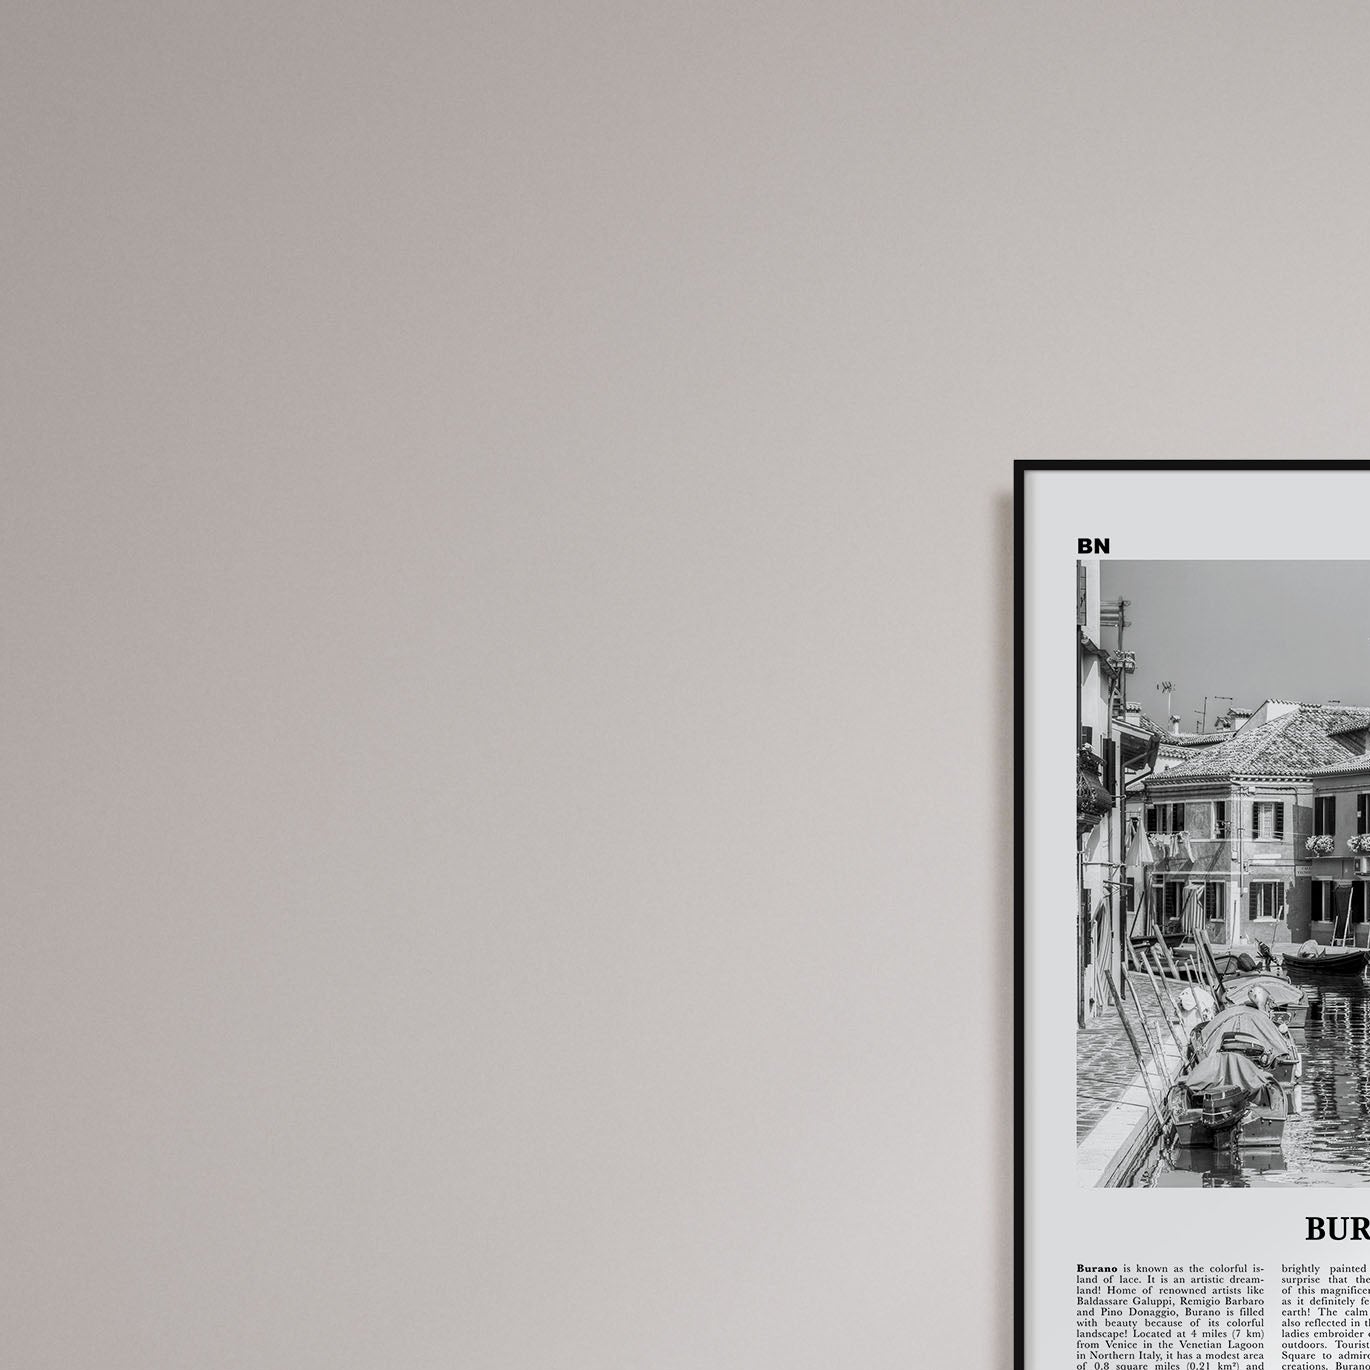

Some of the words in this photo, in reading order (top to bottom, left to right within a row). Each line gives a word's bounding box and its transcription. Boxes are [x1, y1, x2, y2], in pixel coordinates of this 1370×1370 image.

[1077, 538, 1110, 554] BN
[1077, 1264, 1117, 1272] Burano
[1124, 1264, 1130, 1272] is
[1137, 1264, 1168, 1272] known
[1189, 1264, 1204, 1272] the
[1210, 1264, 1247, 1272] colorful
[1253, 1264, 1264, 1272] is-
[1282, 1264, 1320, 1275] brightly
[1330, 1264, 1366, 1275] painted
[1282, 1275, 1320, 1286] surprise
[1329, 1275, 1347, 1283] that
[1356, 1275, 1370, 1283] the
[1077, 1285, 1100, 1294] land!
[1107, 1285, 1136, 1294] Home
[1142, 1285, 1153, 1294] of
[1160, 1285, 1206, 1294] renowned
[1212, 1285, 1241, 1294] artists
[1247, 1285, 1264, 1294] like
[1282, 1285, 1292, 1294] of
[1298, 1285, 1315, 1294] this
[1077, 1296, 1128, 1305] Baldassare
[1133, 1296, 1175, 1308] Galuppi,
[1180, 1296, 1220, 1308] Remigio
[1225, 1296, 1264, 1305] Barbaro
[1077, 1307, 1094, 1316] and
[1101, 1307, 1122, 1316] Pino
[1129, 1307, 1178, 1319] Donaggio,
[1185, 1307, 1220, 1316] Burano
[1227, 1307, 1234, 1316] is
[1240, 1307, 1264, 1316] filled
[1077, 1318, 1097, 1327] with
[1105, 1318, 1137, 1329] beauty
[1145, 1318, 1182, 1327] because
[1190, 1318, 1201, 1327] of
[1209, 1318, 1219, 1327] its
[1227, 1318, 1264, 1327] colorful
[1282, 1329, 1309, 1338] ladies
[1314, 1329, 1364, 1338] embroider
[1077, 1340, 1099, 1349] from
[1105, 1340, 1137, 1349] Venice
[1144, 1340, 1152, 1349] in
[1159, 1340, 1173, 1349] the
[1179, 1340, 1221, 1349] Venetian
[1228, 1340, 1264, 1351] Lagoon
[1282, 1340, 1327, 1349] outdoors.
[1282, 1351, 1315, 1362] Square
[1323, 1351, 1332, 1359] to
[1282, 1362, 1328, 1370] creations.
[1336, 1362, 1370, 1370] Burano
